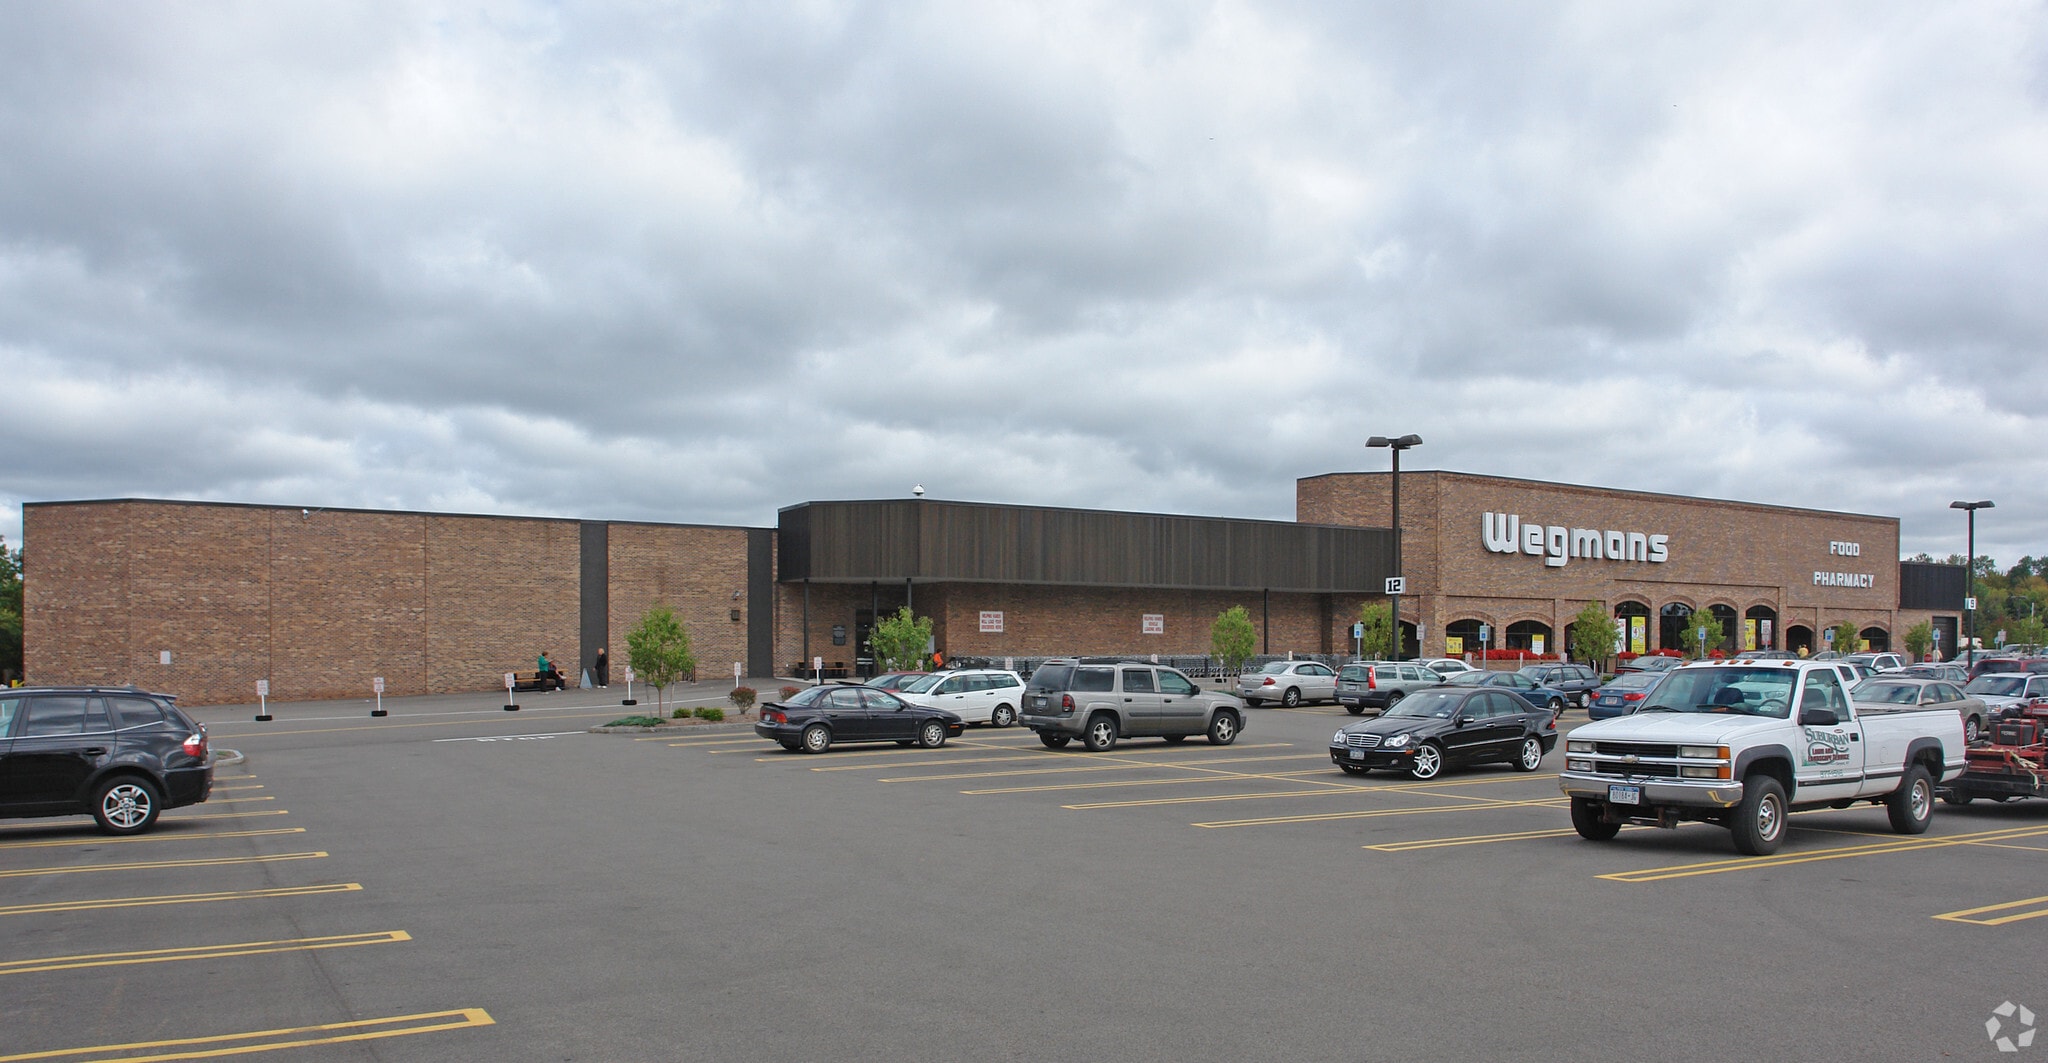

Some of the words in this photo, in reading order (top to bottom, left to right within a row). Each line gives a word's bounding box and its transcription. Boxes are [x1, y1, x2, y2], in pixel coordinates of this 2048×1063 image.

[1482, 512, 1669, 567] Wegmans
[1829, 541, 1860, 556] FOOD
[1387, 579, 1401, 592] 12
[1813, 571, 1875, 588] PHARMACY
[1805, 728, 1849, 745] SUBURBAN
